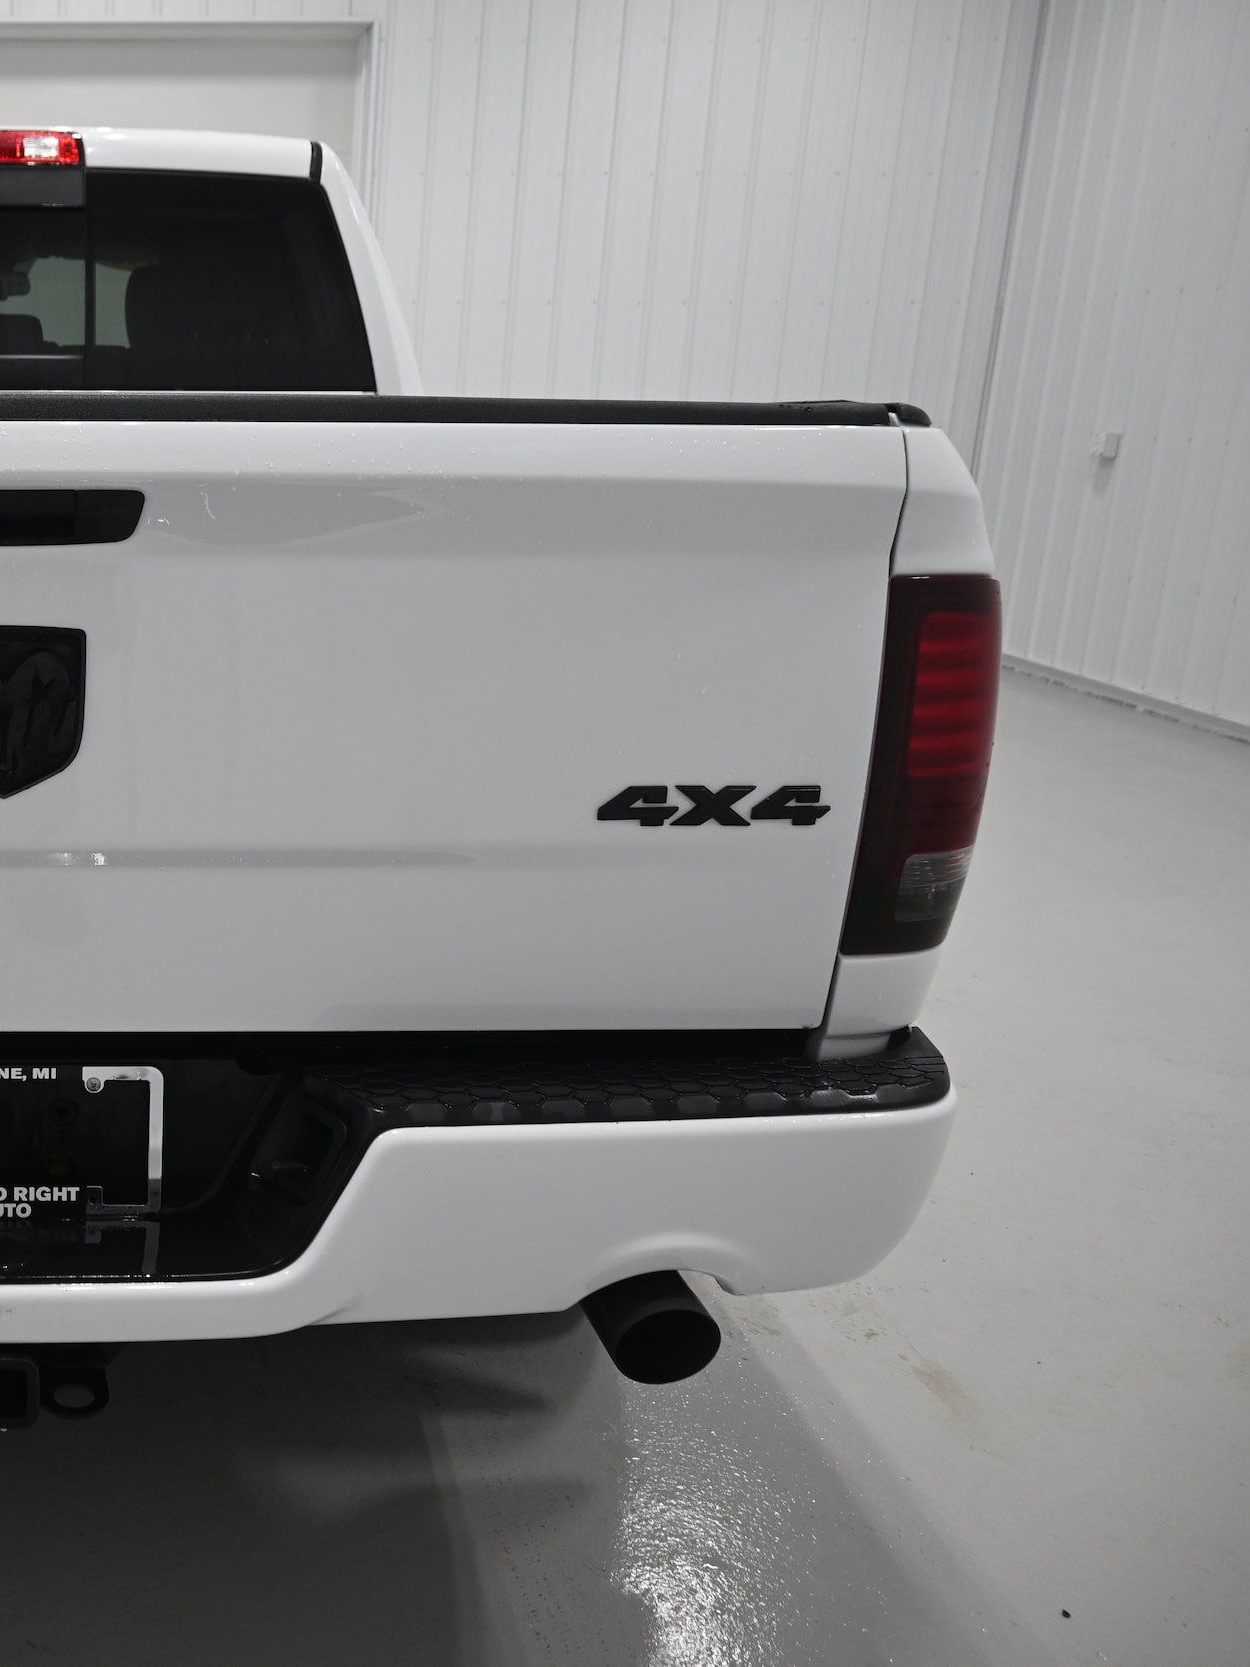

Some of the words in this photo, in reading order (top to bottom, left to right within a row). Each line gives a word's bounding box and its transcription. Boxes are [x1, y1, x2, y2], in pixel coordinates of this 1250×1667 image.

[597, 785, 831, 827] 4X4
[32, 1067, 57, 1080] MI
[13, 1186, 80, 1202] RIGHT
